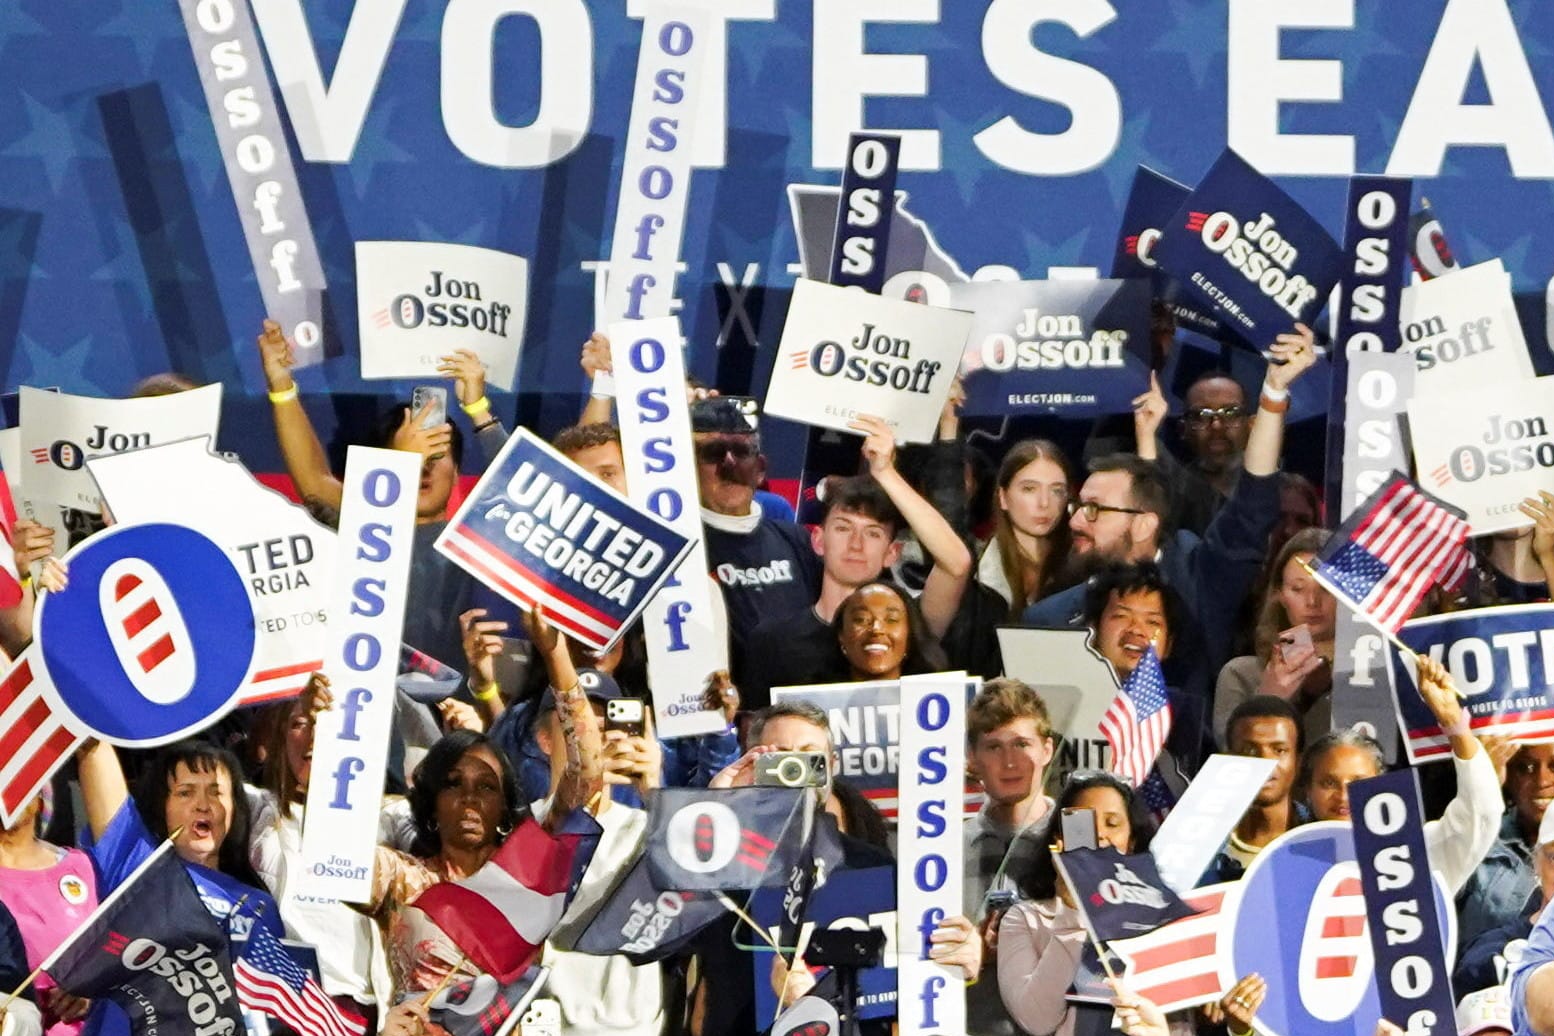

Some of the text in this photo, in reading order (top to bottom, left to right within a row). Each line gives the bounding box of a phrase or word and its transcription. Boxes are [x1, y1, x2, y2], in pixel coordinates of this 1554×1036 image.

[250, 0, 1122, 176] VOTES
[1242, 212, 1298, 271] Jon
[424, 271, 482, 301] Jon
[1202, 211, 1318, 320] Ossoff
[391, 293, 513, 338] Ossoff
[1016, 307, 1083, 338] Jon
[1400, 314, 1447, 344] on
[851, 323, 911, 359] Jon
[981, 329, 1128, 371] Ossoff
[809, 340, 942, 396] Ossoff
[1482, 415, 1549, 446] Jon
[506, 461, 666, 579] UNITED
[238, 534, 315, 575] TED
[502, 509, 638, 608] GEORGIA
[717, 560, 793, 586] Ossoff
[251, 569, 310, 598] RGIA
[174, 943, 233, 1005] Jon
